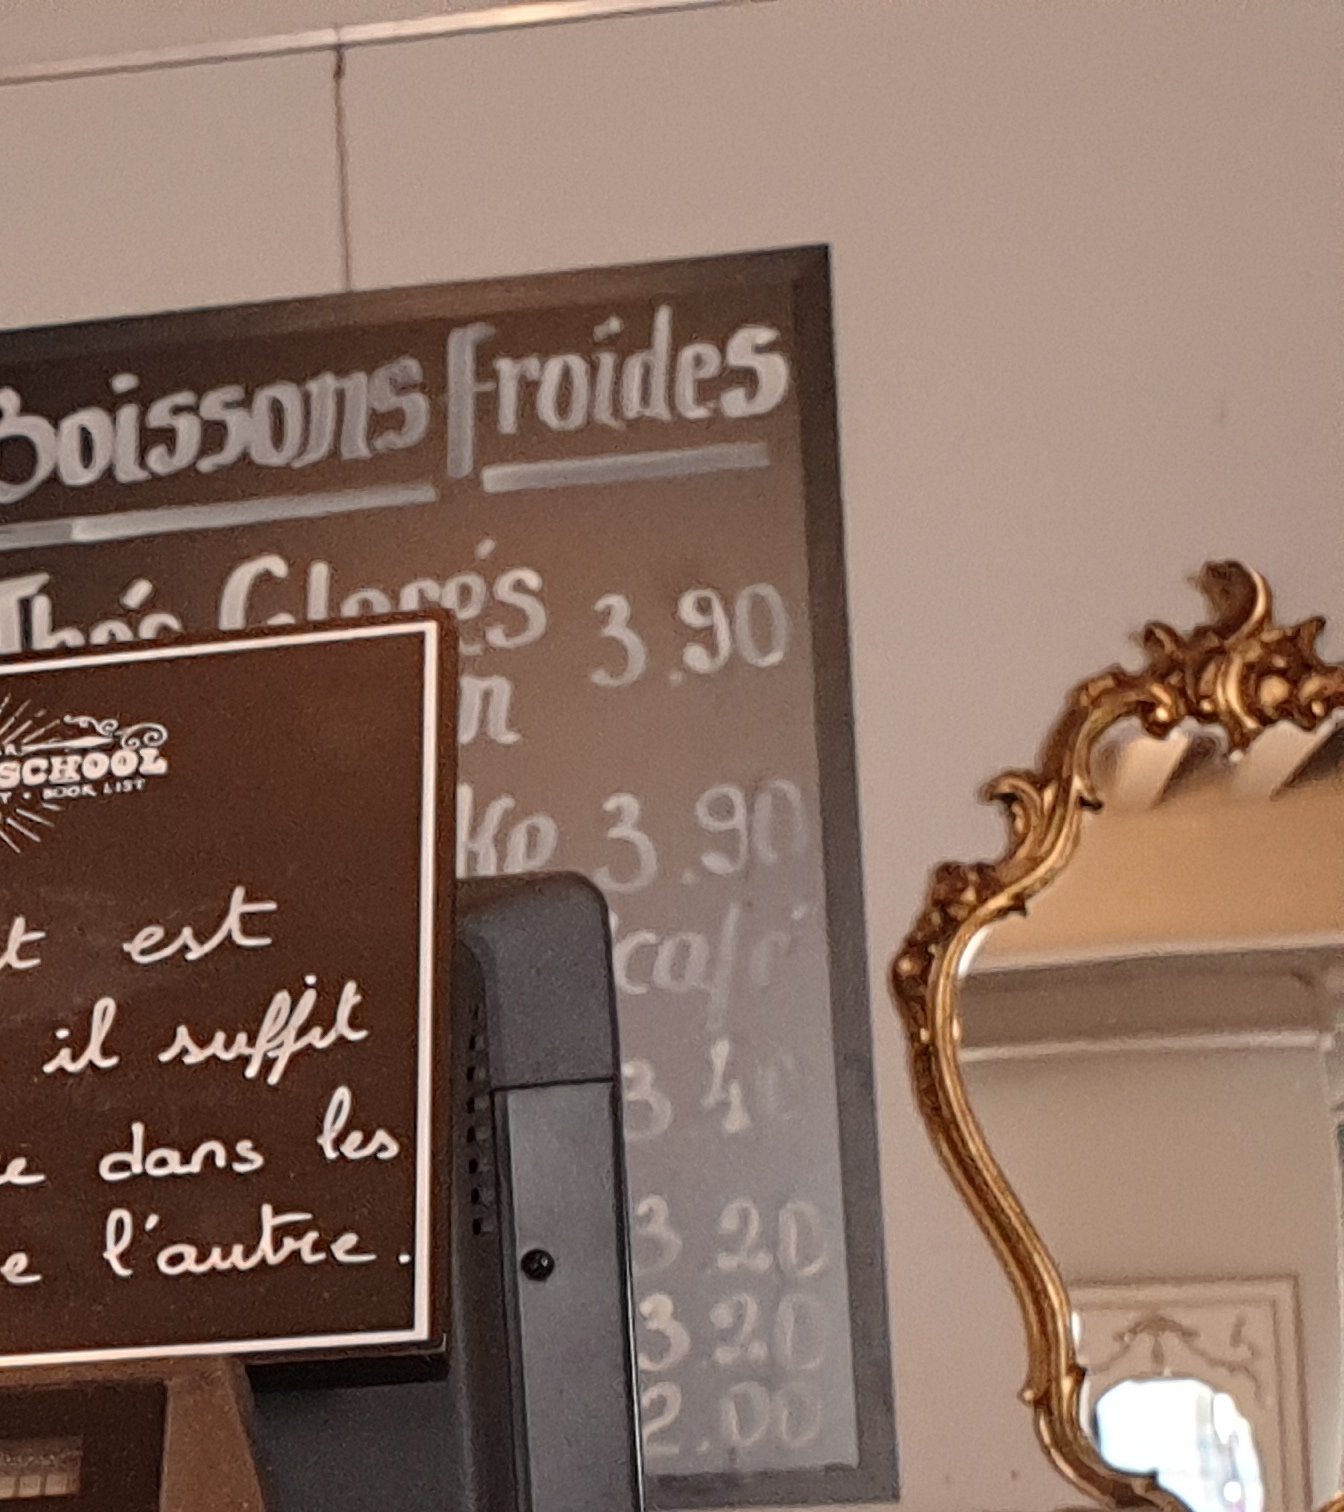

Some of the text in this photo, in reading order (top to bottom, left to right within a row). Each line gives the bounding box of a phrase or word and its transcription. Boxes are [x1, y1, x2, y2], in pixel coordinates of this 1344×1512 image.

[591, 581, 791, 690] 3.90
[103, 778, 147, 795] LIST
[594, 778, 806, 894] 3.90
[123, 885, 278, 965] est
[42, 997, 120, 1077] il
[158, 973, 370, 1087] suffit
[99, 1122, 265, 1185] dans
[316, 1084, 401, 1163] les
